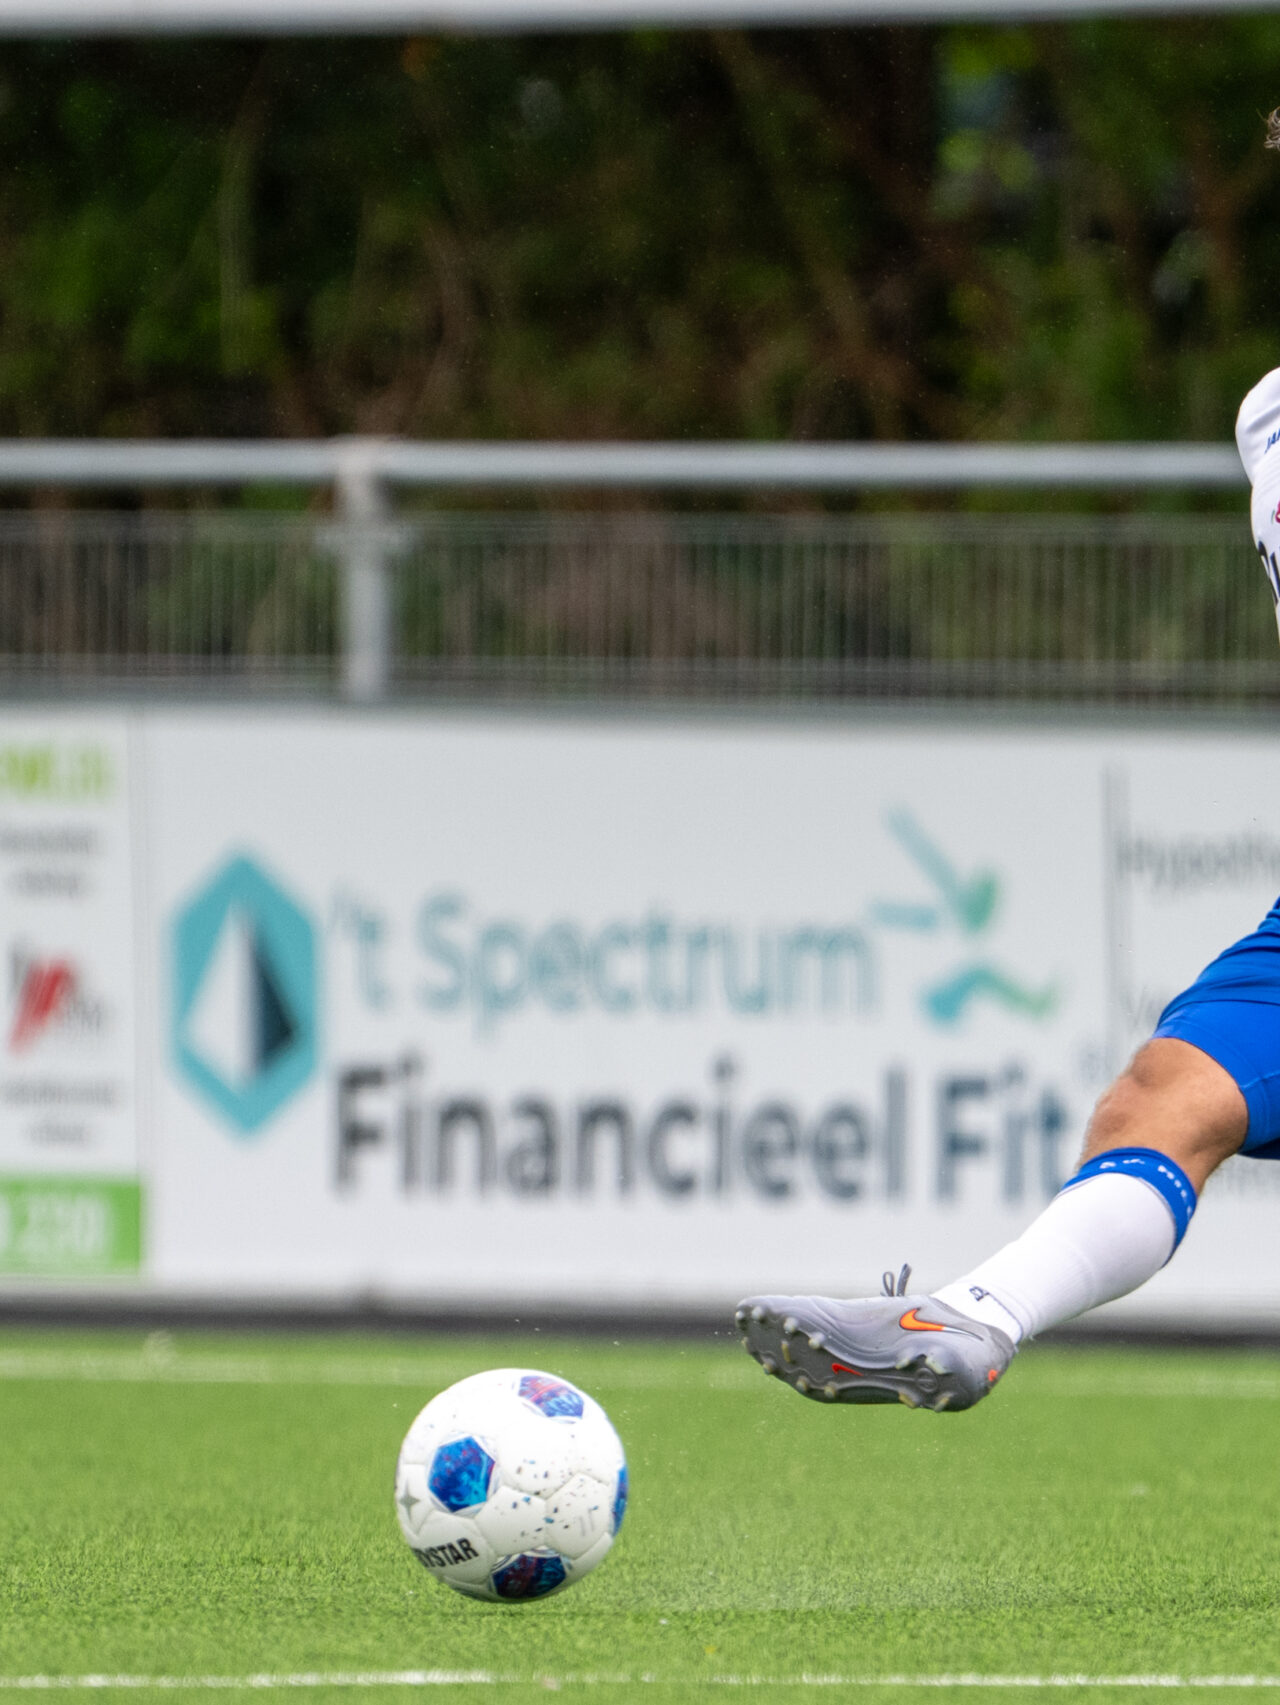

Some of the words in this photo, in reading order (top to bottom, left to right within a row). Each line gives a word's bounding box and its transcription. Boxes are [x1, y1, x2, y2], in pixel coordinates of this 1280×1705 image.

[416, 892, 878, 1038] Spectrum
[335, 1052, 912, 1206] Financieel
[936, 1060, 1072, 1206] Fit
